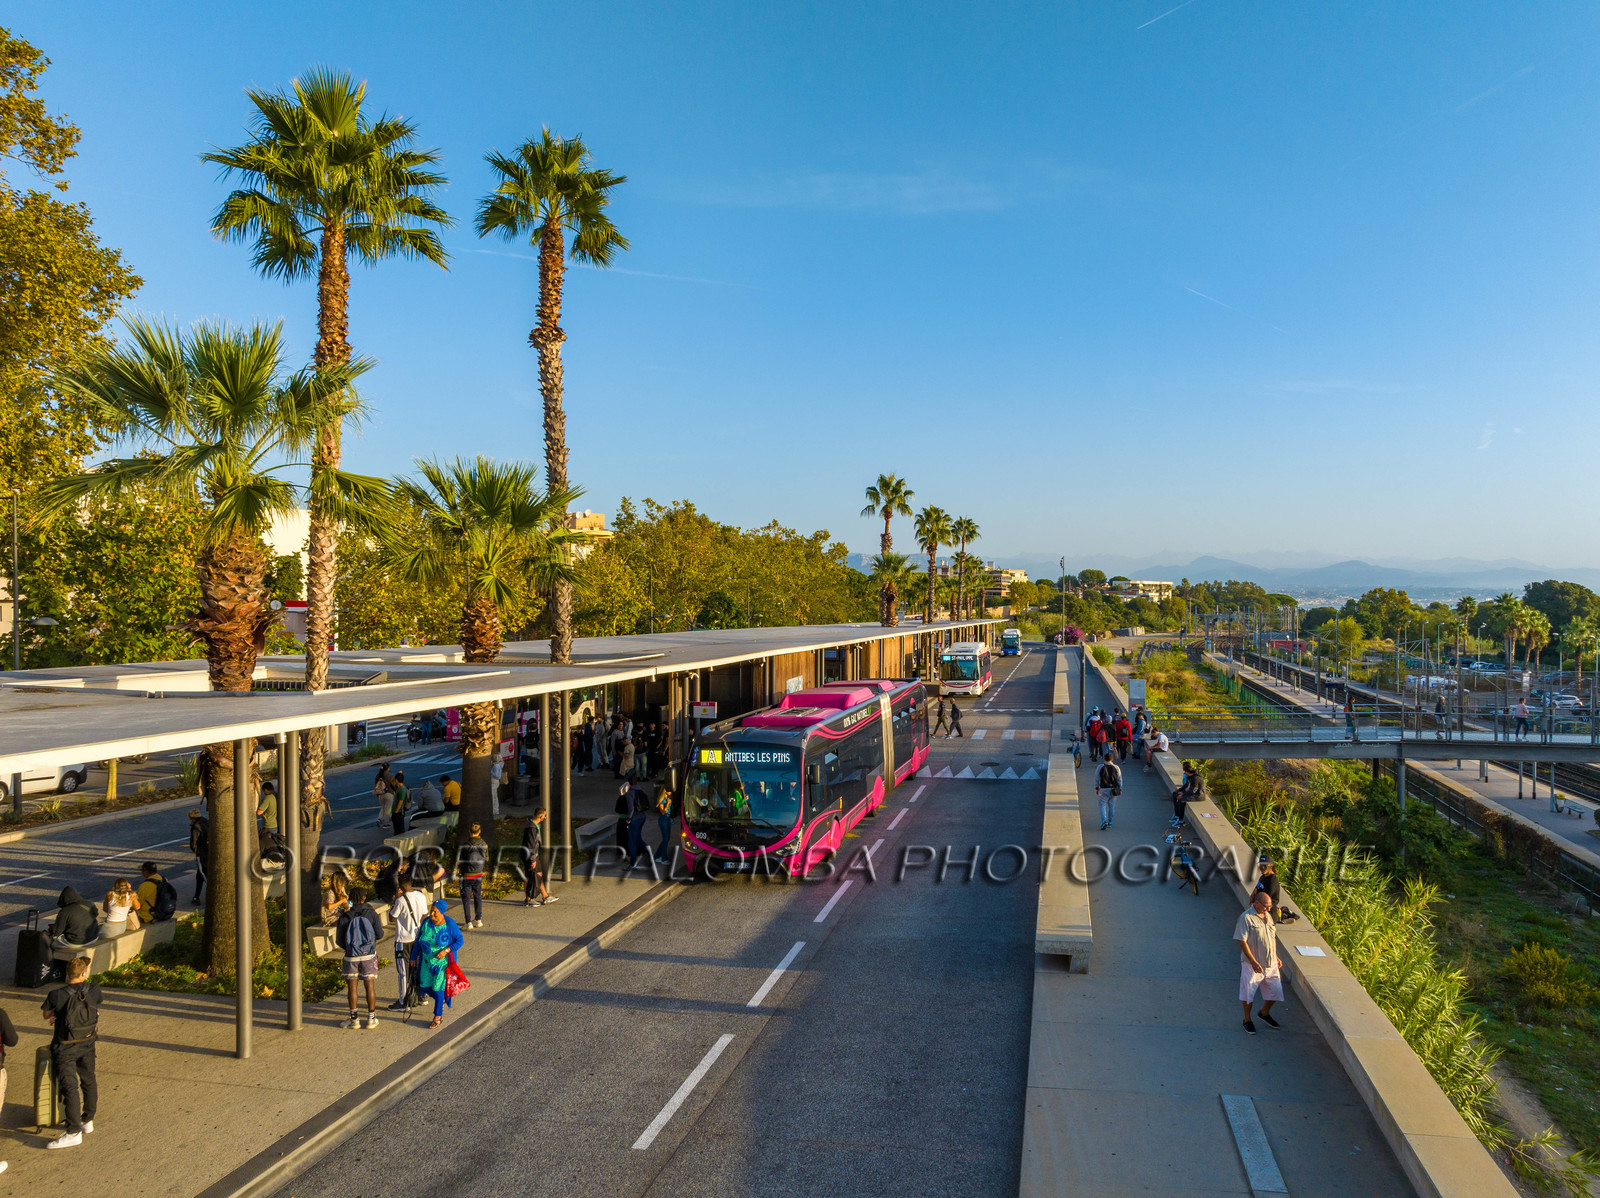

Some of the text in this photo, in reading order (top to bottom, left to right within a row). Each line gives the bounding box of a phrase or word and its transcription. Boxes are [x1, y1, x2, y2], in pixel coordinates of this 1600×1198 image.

[707, 750, 791, 764] A ANTIBES LES PINS
[695, 832, 707, 840] 609
